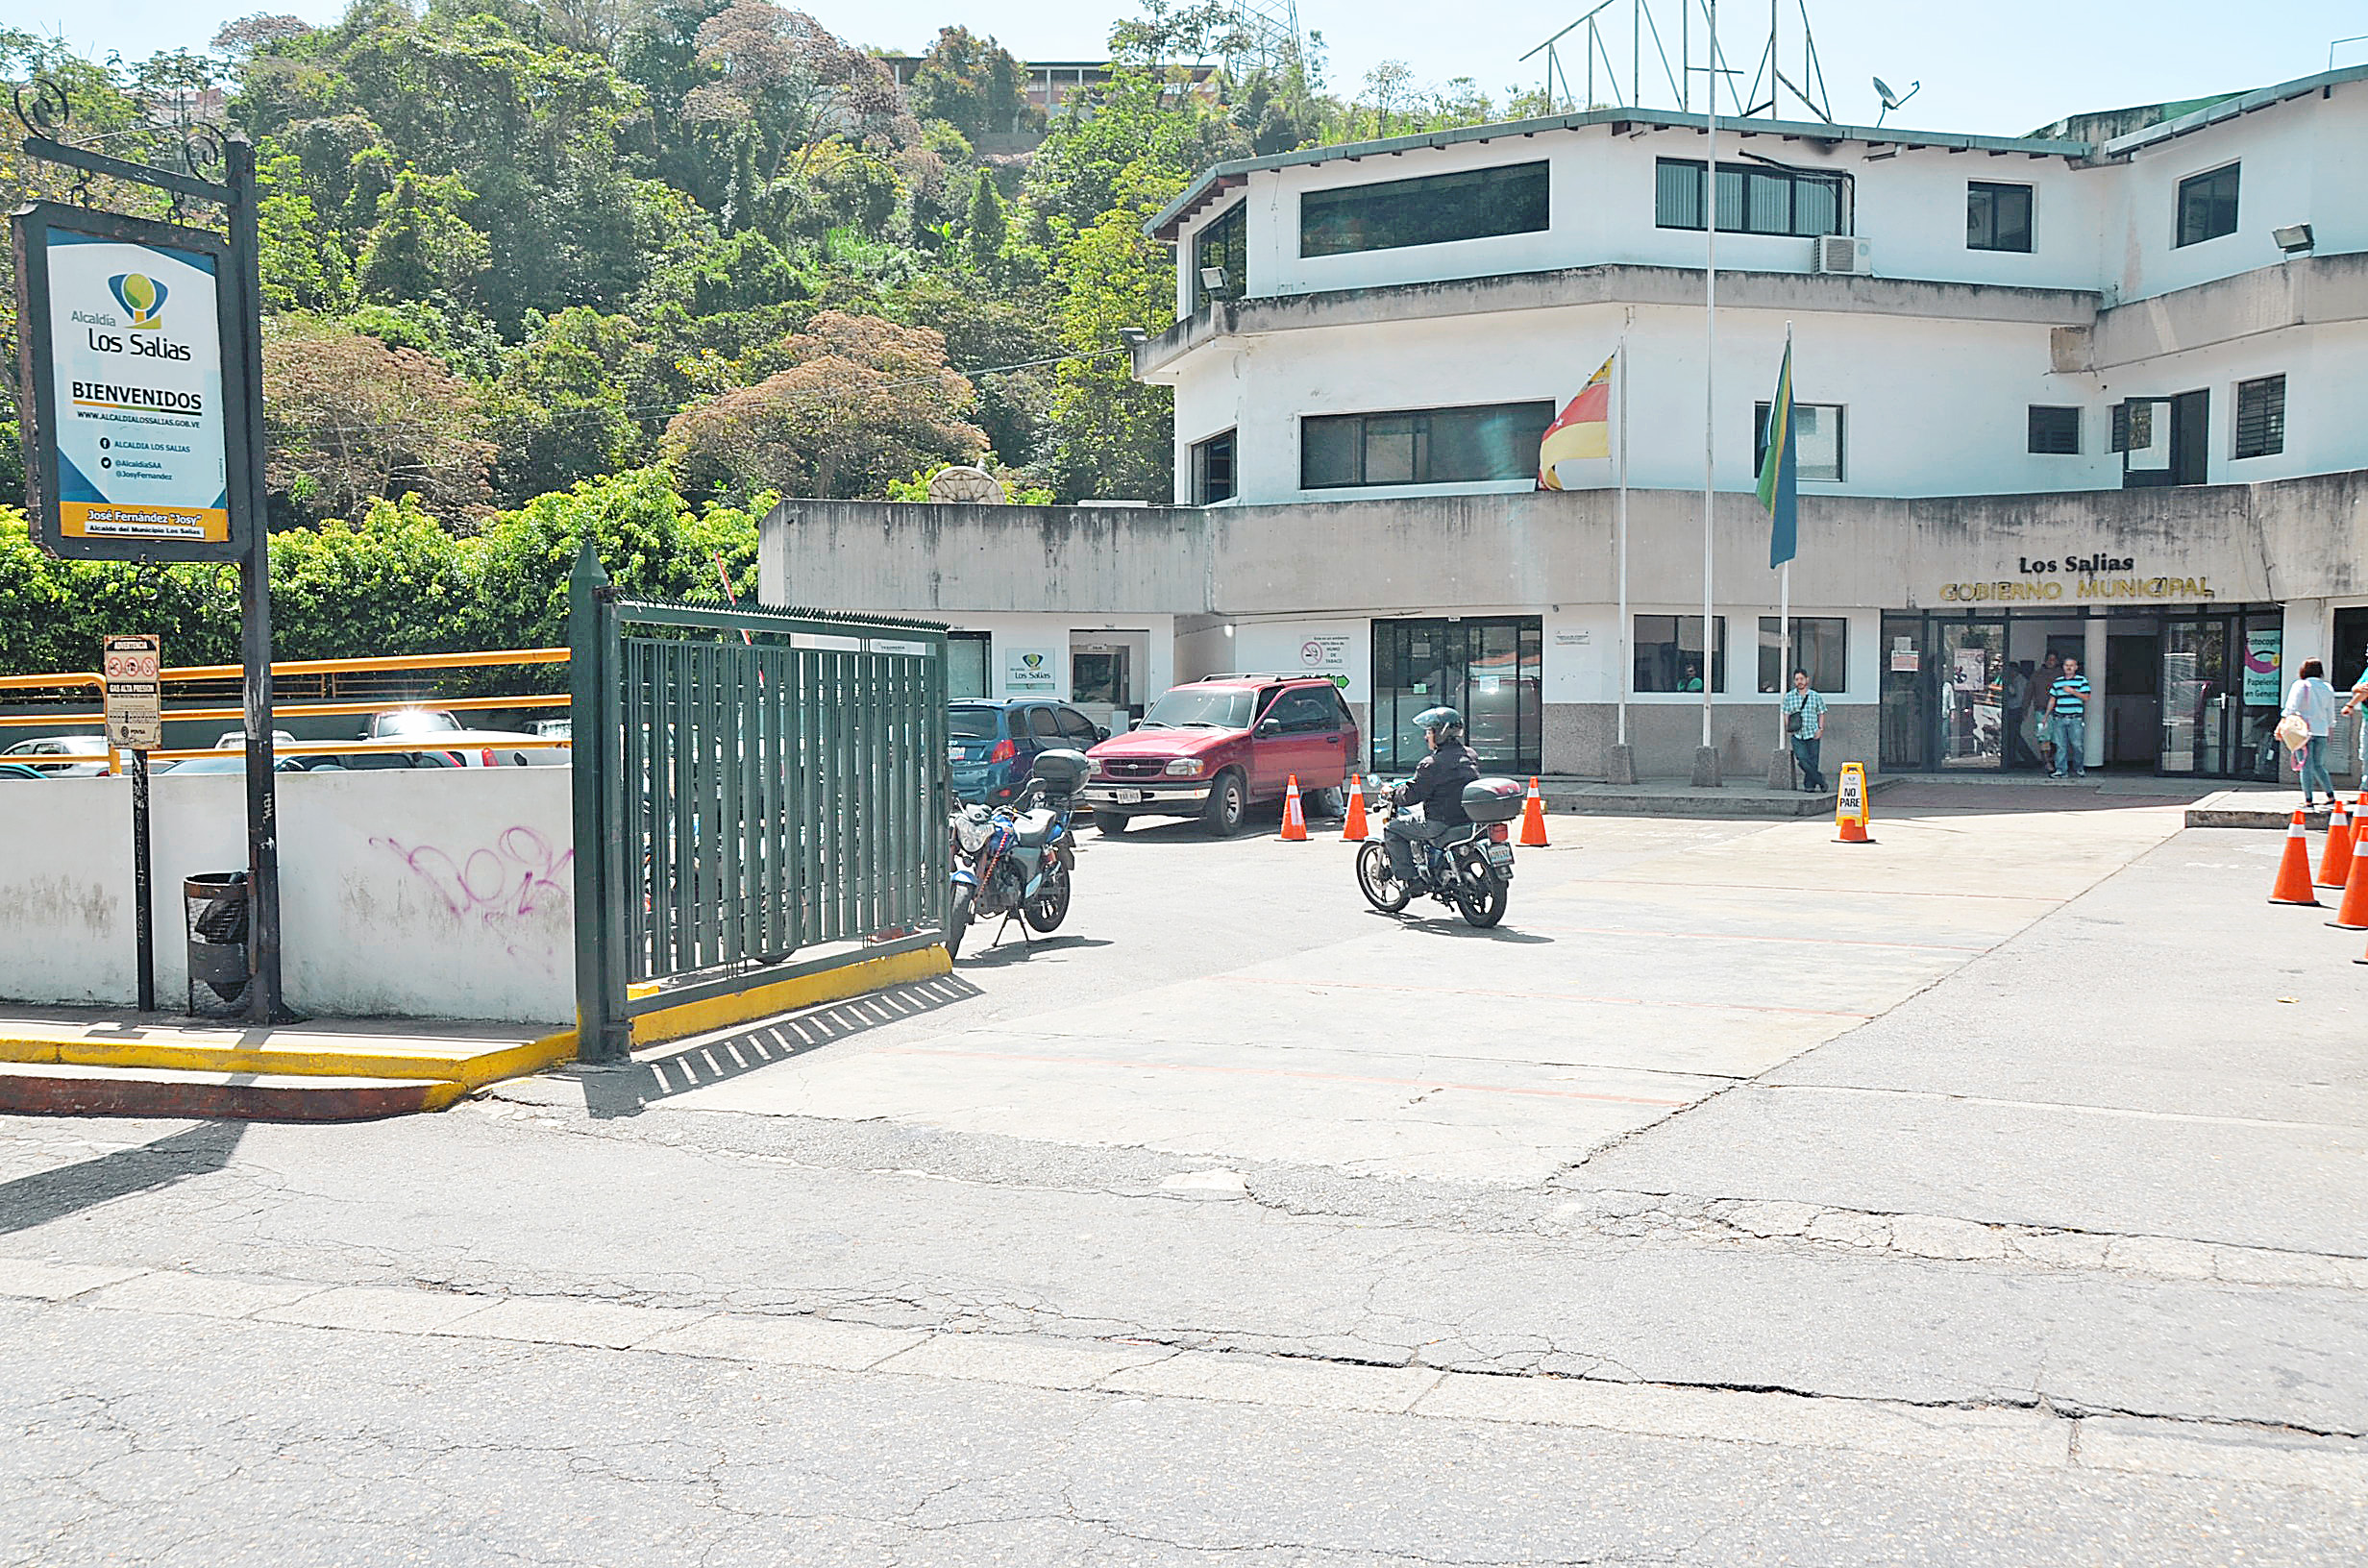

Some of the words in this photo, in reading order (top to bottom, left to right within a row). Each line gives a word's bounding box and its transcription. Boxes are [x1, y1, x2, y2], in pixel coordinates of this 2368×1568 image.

[71, 310, 116, 327] Alcaldía
[130, 334, 191, 361] Salias
[72, 381, 202, 409] BIENVENIDOS
[77, 411, 200, 429] WWW.ALCALDIALOSSALIAS.GOB.VE
[114, 441, 150, 451] ALCALDIA
[87, 509, 112, 521] José
[114, 510, 168, 524] Fernández
[2019, 557, 2058, 575] Los
[2064, 553, 2134, 573] Salias
[1939, 581, 2062, 601] GOBIERNO
[2076, 576, 2214, 599] MUNICIPAL
[1844, 787, 1856, 796] NO
[1839, 797, 1861, 807] PARE
